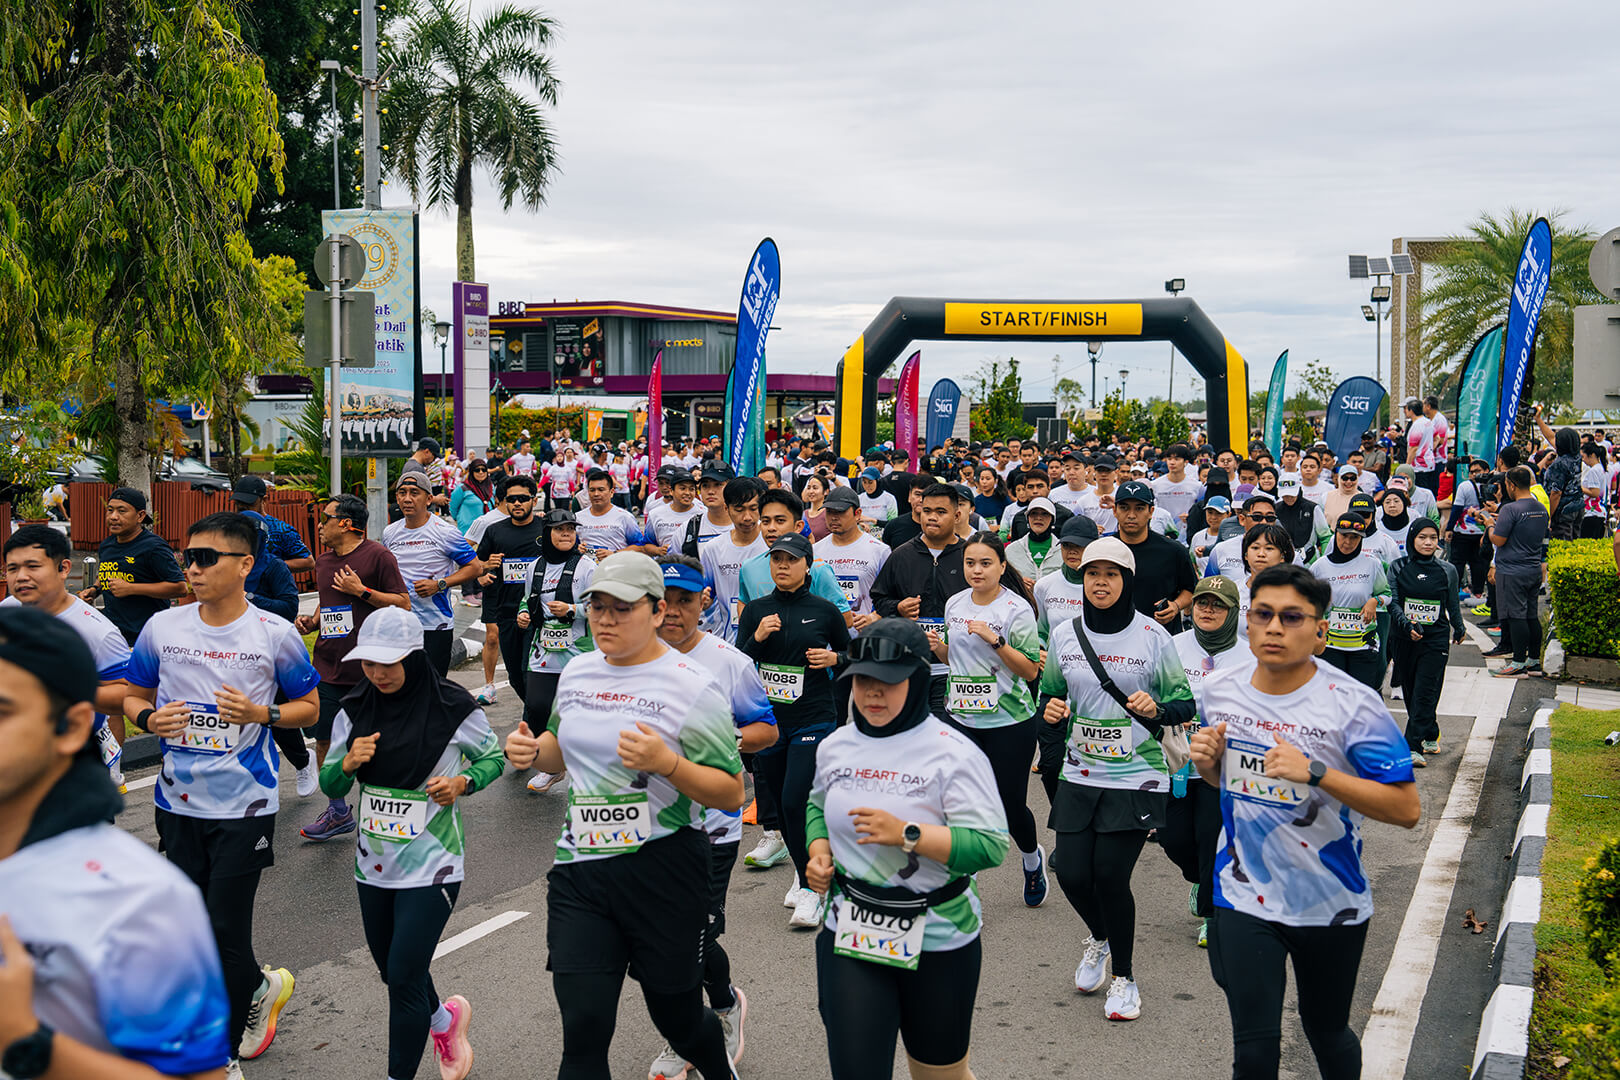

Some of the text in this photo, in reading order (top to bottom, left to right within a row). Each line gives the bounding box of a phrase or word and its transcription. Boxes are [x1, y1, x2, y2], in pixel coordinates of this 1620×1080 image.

[361, 243, 386, 272] 9
[498, 301, 527, 316] BIBD
[980, 311, 1107, 326] START/FINISH
[375, 338, 405, 352] atik
[1508, 347, 1528, 419] CARDIO
[1525, 272, 1548, 347] FITNESS
[742, 358, 759, 423] CARDIO
[757, 290, 778, 358] FITNESS
[1469, 368, 1486, 443] FITNESS
[904, 418, 912, 444] YOUR
[1408, 603, 1436, 612] W054
[1338, 612, 1362, 620] W116
[162, 646, 262, 662] WORLD HEART DAY
[1061, 654, 1088, 662] WORL
[1128, 658, 1146, 666] DAY
[762, 671, 798, 684] W088
[956, 684, 992, 694] W093
[596, 692, 636, 703] HEART
[637, 697, 667, 713] DAY
[1082, 726, 1122, 739] W123
[1256, 720, 1296, 734] HEART
[1300, 725, 1328, 739] DAY
[855, 768, 899, 781] HEART
[901, 774, 928, 785] DAY
[370, 798, 412, 815] W117
[580, 806, 640, 822] W060
[852, 905, 912, 932] W070
